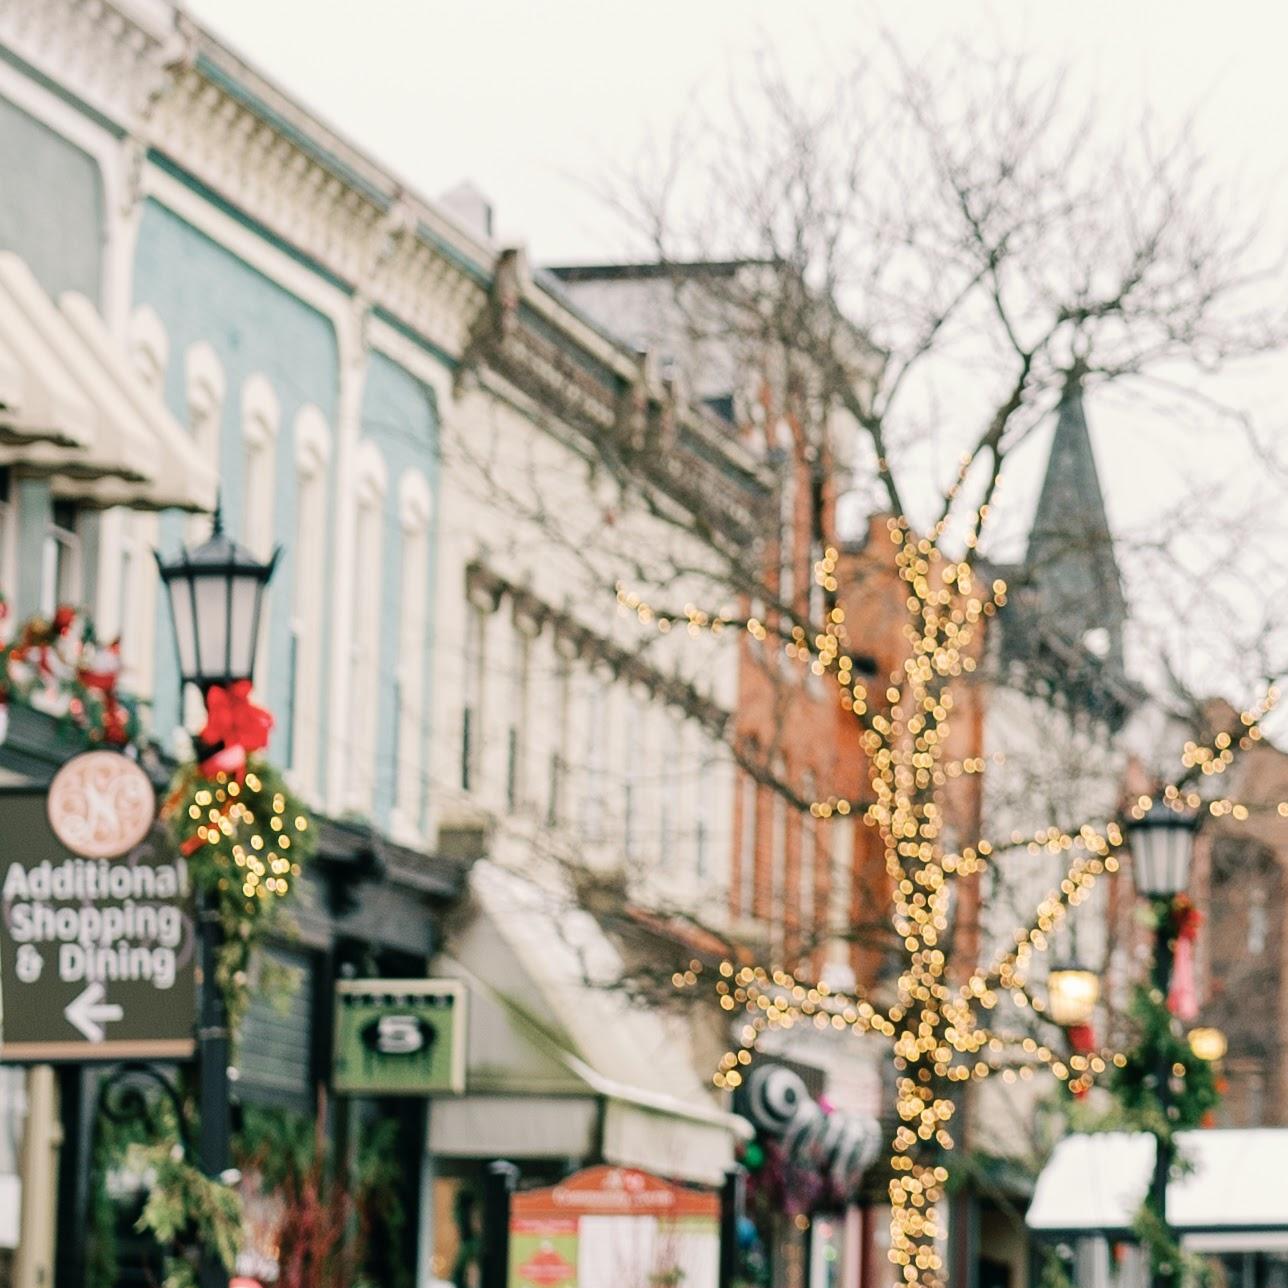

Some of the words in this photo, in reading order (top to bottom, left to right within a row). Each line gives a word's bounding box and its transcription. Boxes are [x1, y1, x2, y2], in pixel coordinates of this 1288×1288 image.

[3, 858, 191, 901] Additional
[10, 899, 182, 948] Shopping
[15, 943, 44, 984] &
[59, 940, 177, 990] Dining
